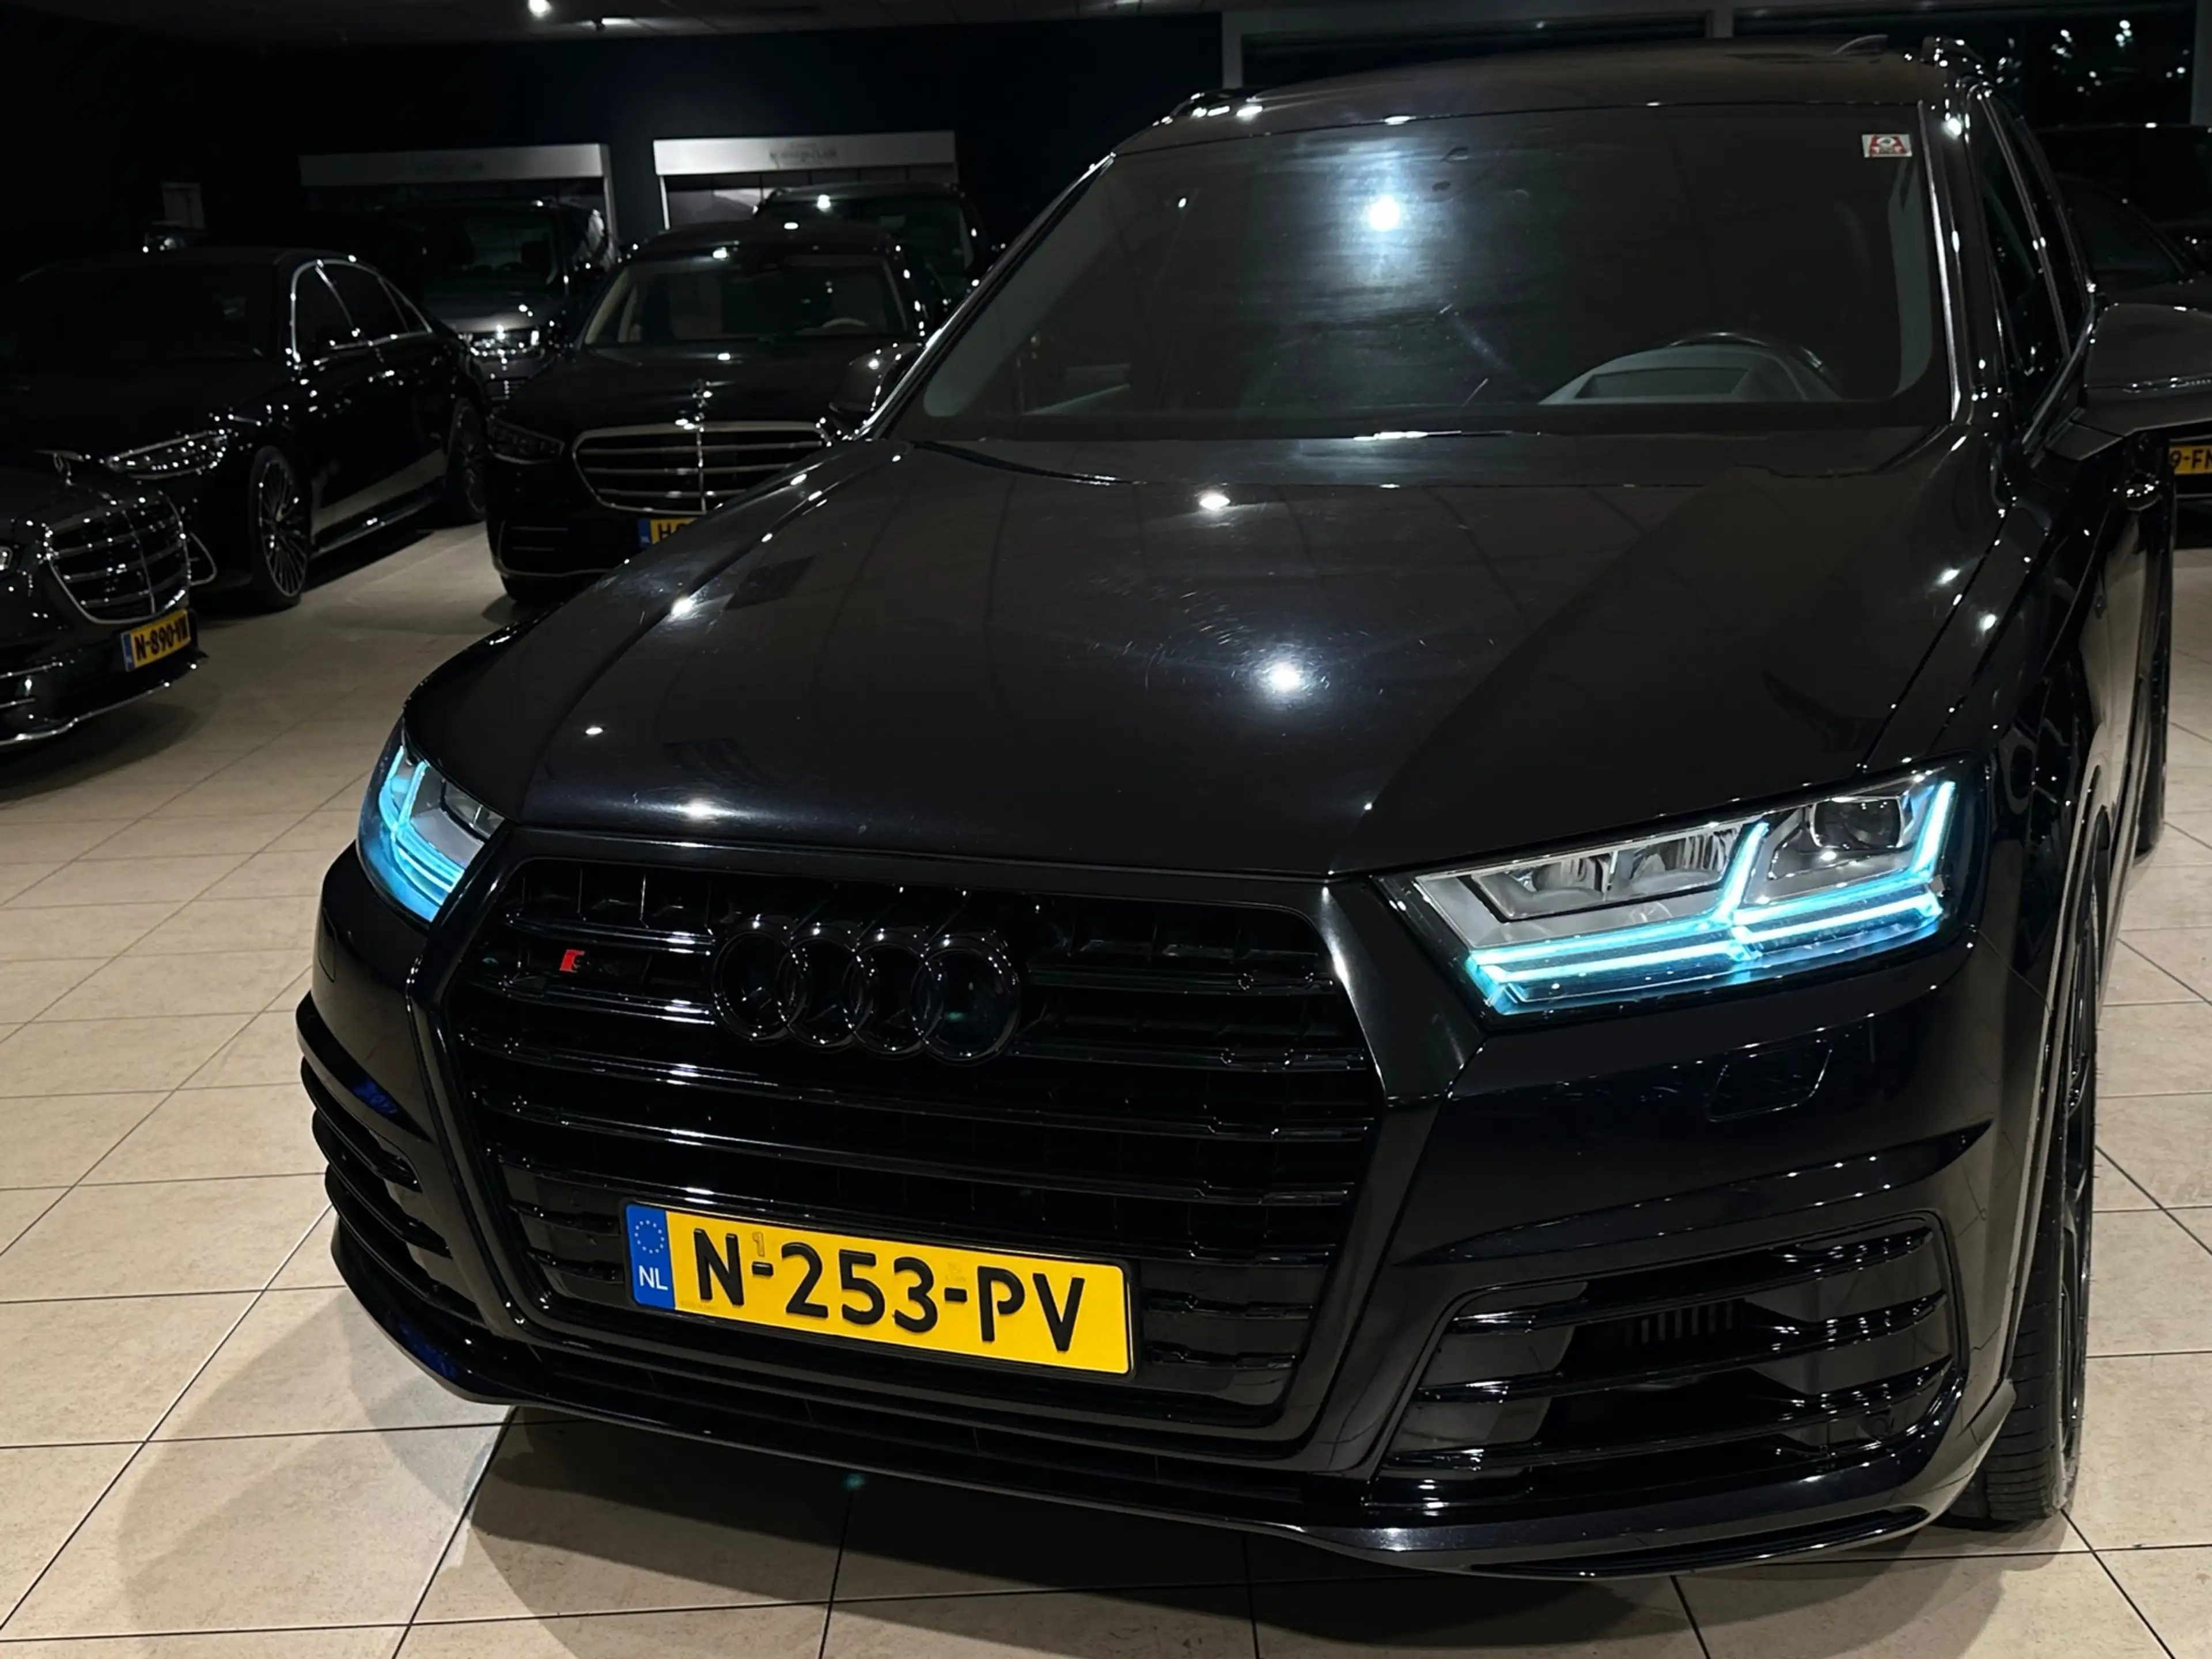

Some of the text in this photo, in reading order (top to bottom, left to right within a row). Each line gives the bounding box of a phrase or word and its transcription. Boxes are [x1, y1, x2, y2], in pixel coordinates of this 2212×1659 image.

[752, 1232, 765, 1257] 1
[638, 1265, 668, 1291] NL
[693, 1228, 1085, 1353] N-253-PV
